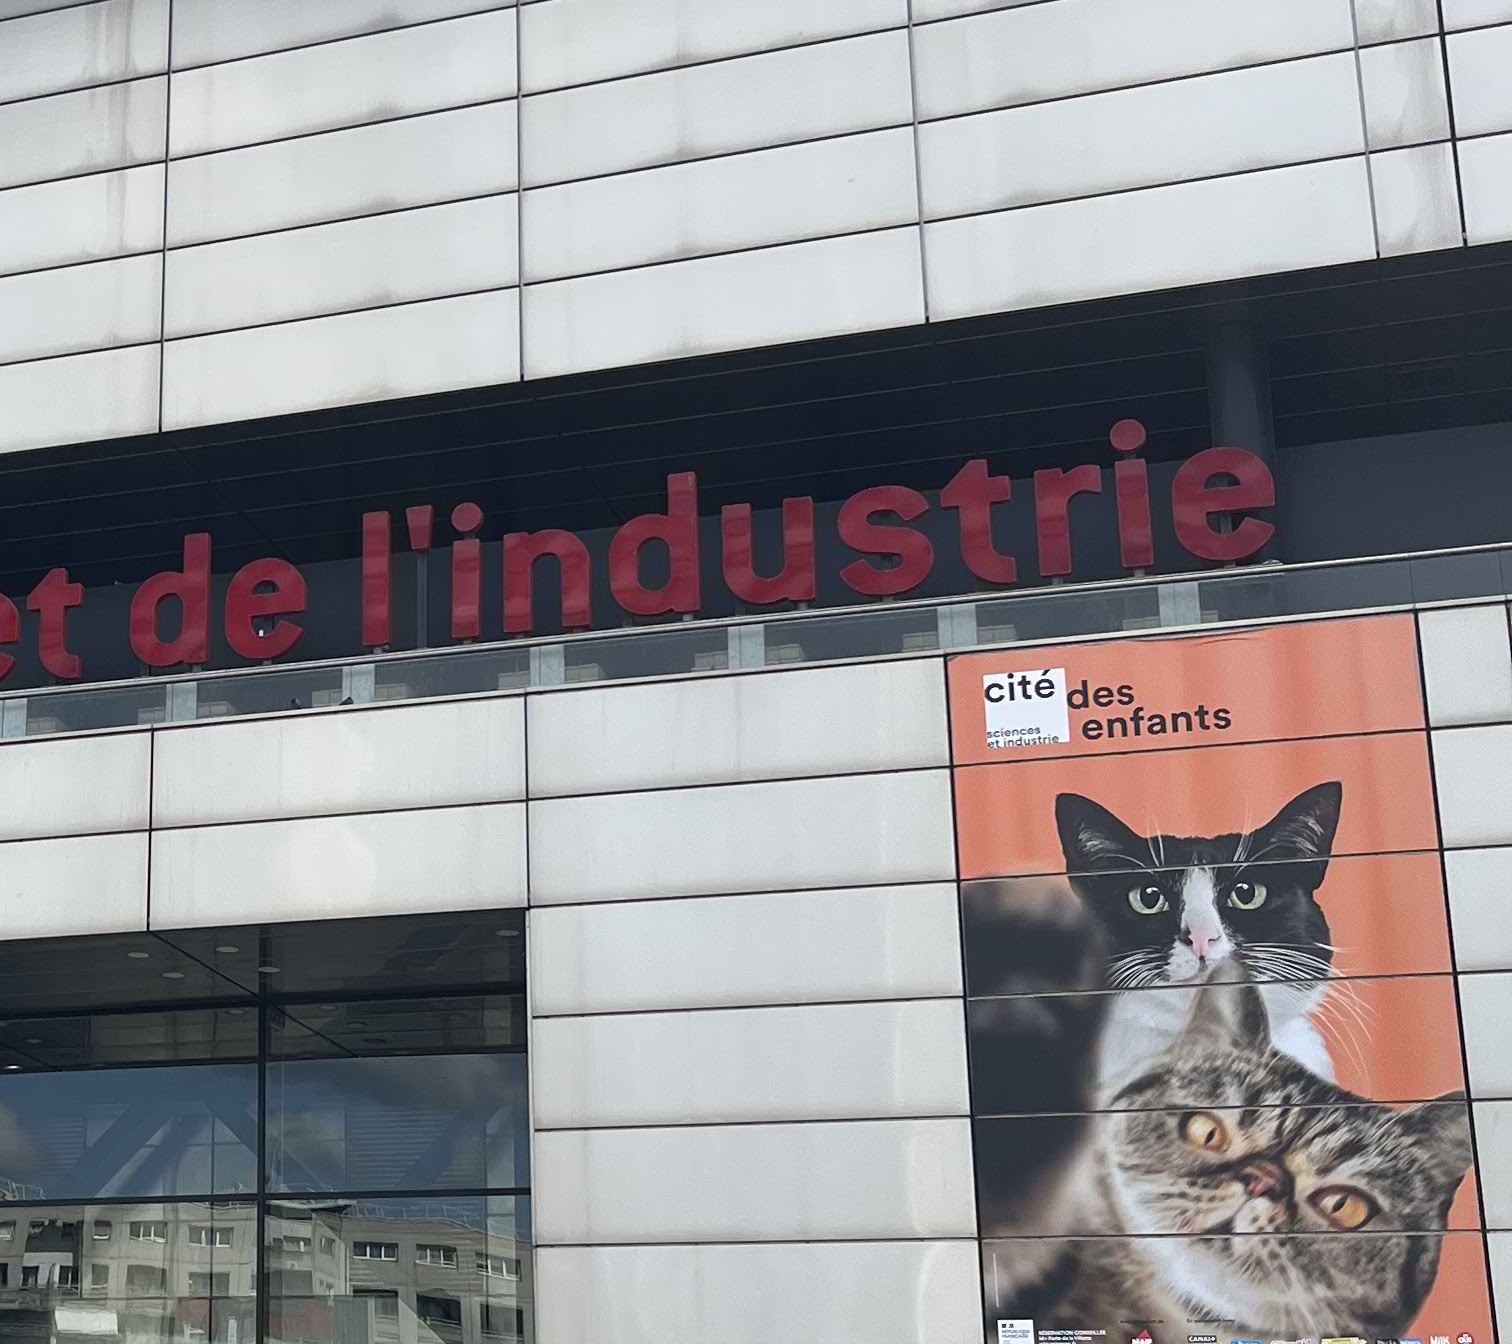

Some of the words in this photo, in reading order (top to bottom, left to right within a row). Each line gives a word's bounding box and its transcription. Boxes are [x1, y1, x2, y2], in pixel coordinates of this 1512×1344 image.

[128, 532, 307, 667] de
[361, 418, 1277, 649] l'industrie
[984, 668, 1055, 703] cité
[1066, 679, 1135, 710] des
[986, 725, 1041, 738] sciences
[1082, 704, 1232, 741] enfants
[987, 738, 1001, 749] et
[1003, 734, 1059, 749] industrie
